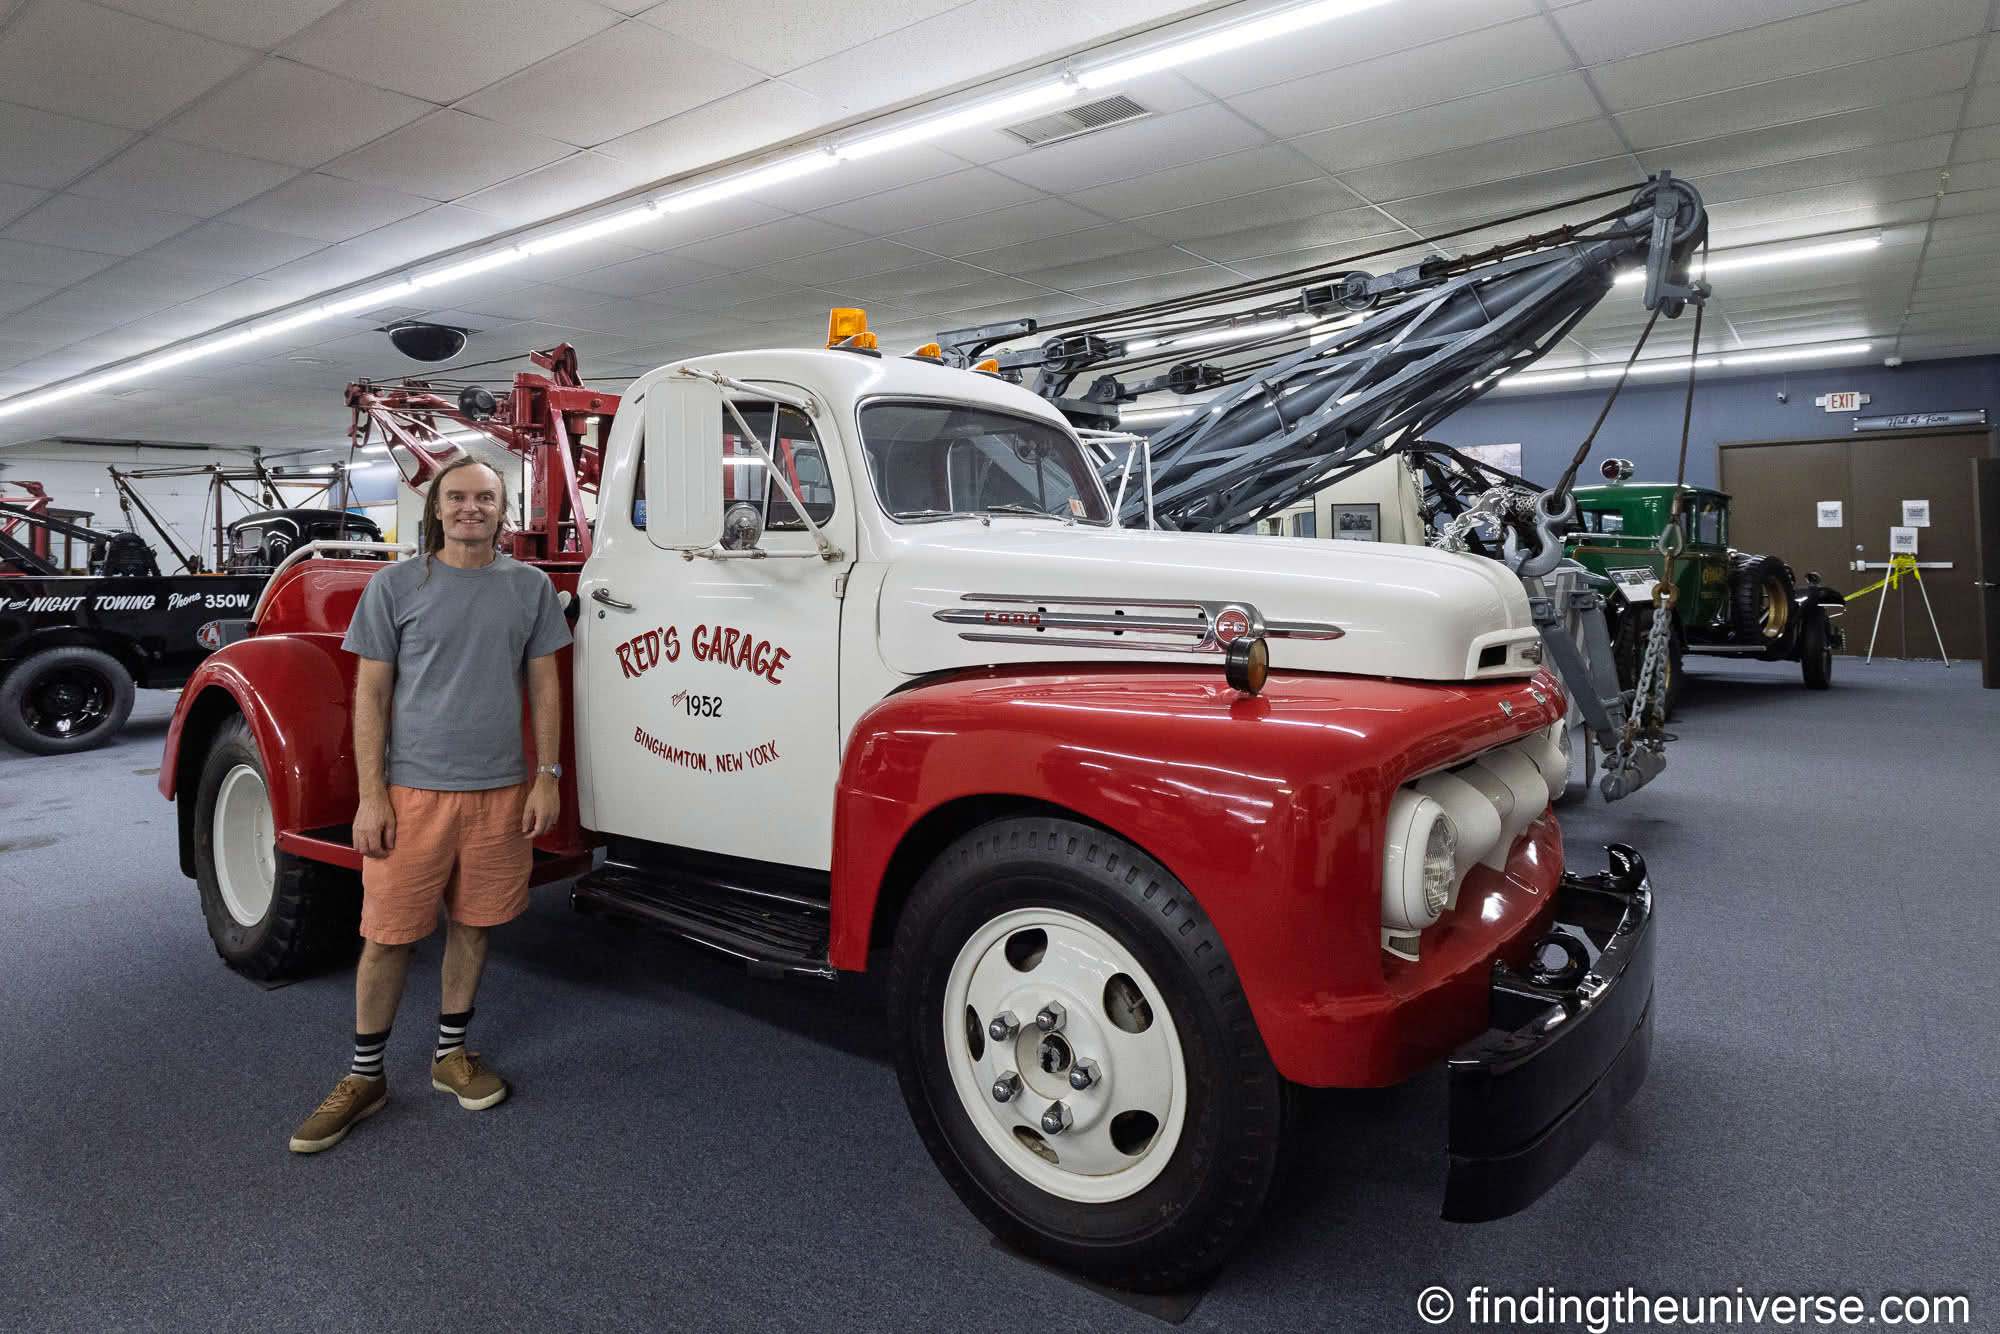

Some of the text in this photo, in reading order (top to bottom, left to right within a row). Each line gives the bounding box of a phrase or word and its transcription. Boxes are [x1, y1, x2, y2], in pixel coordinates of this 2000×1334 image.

[1831, 393, 1855, 409] EXIT
[9, 598, 30, 609] and
[28, 596, 86, 612] NIGHT
[93, 595, 156, 611] TOWING
[167, 592, 201, 611] Phone
[204, 594, 250, 609] 350W
[984, 611, 1041, 625] FORD
[615, 624, 792, 685] RED'S GARAGE
[686, 695, 723, 718] 1952
[634, 726, 780, 774] BINGHAMTON, NEW YORK
